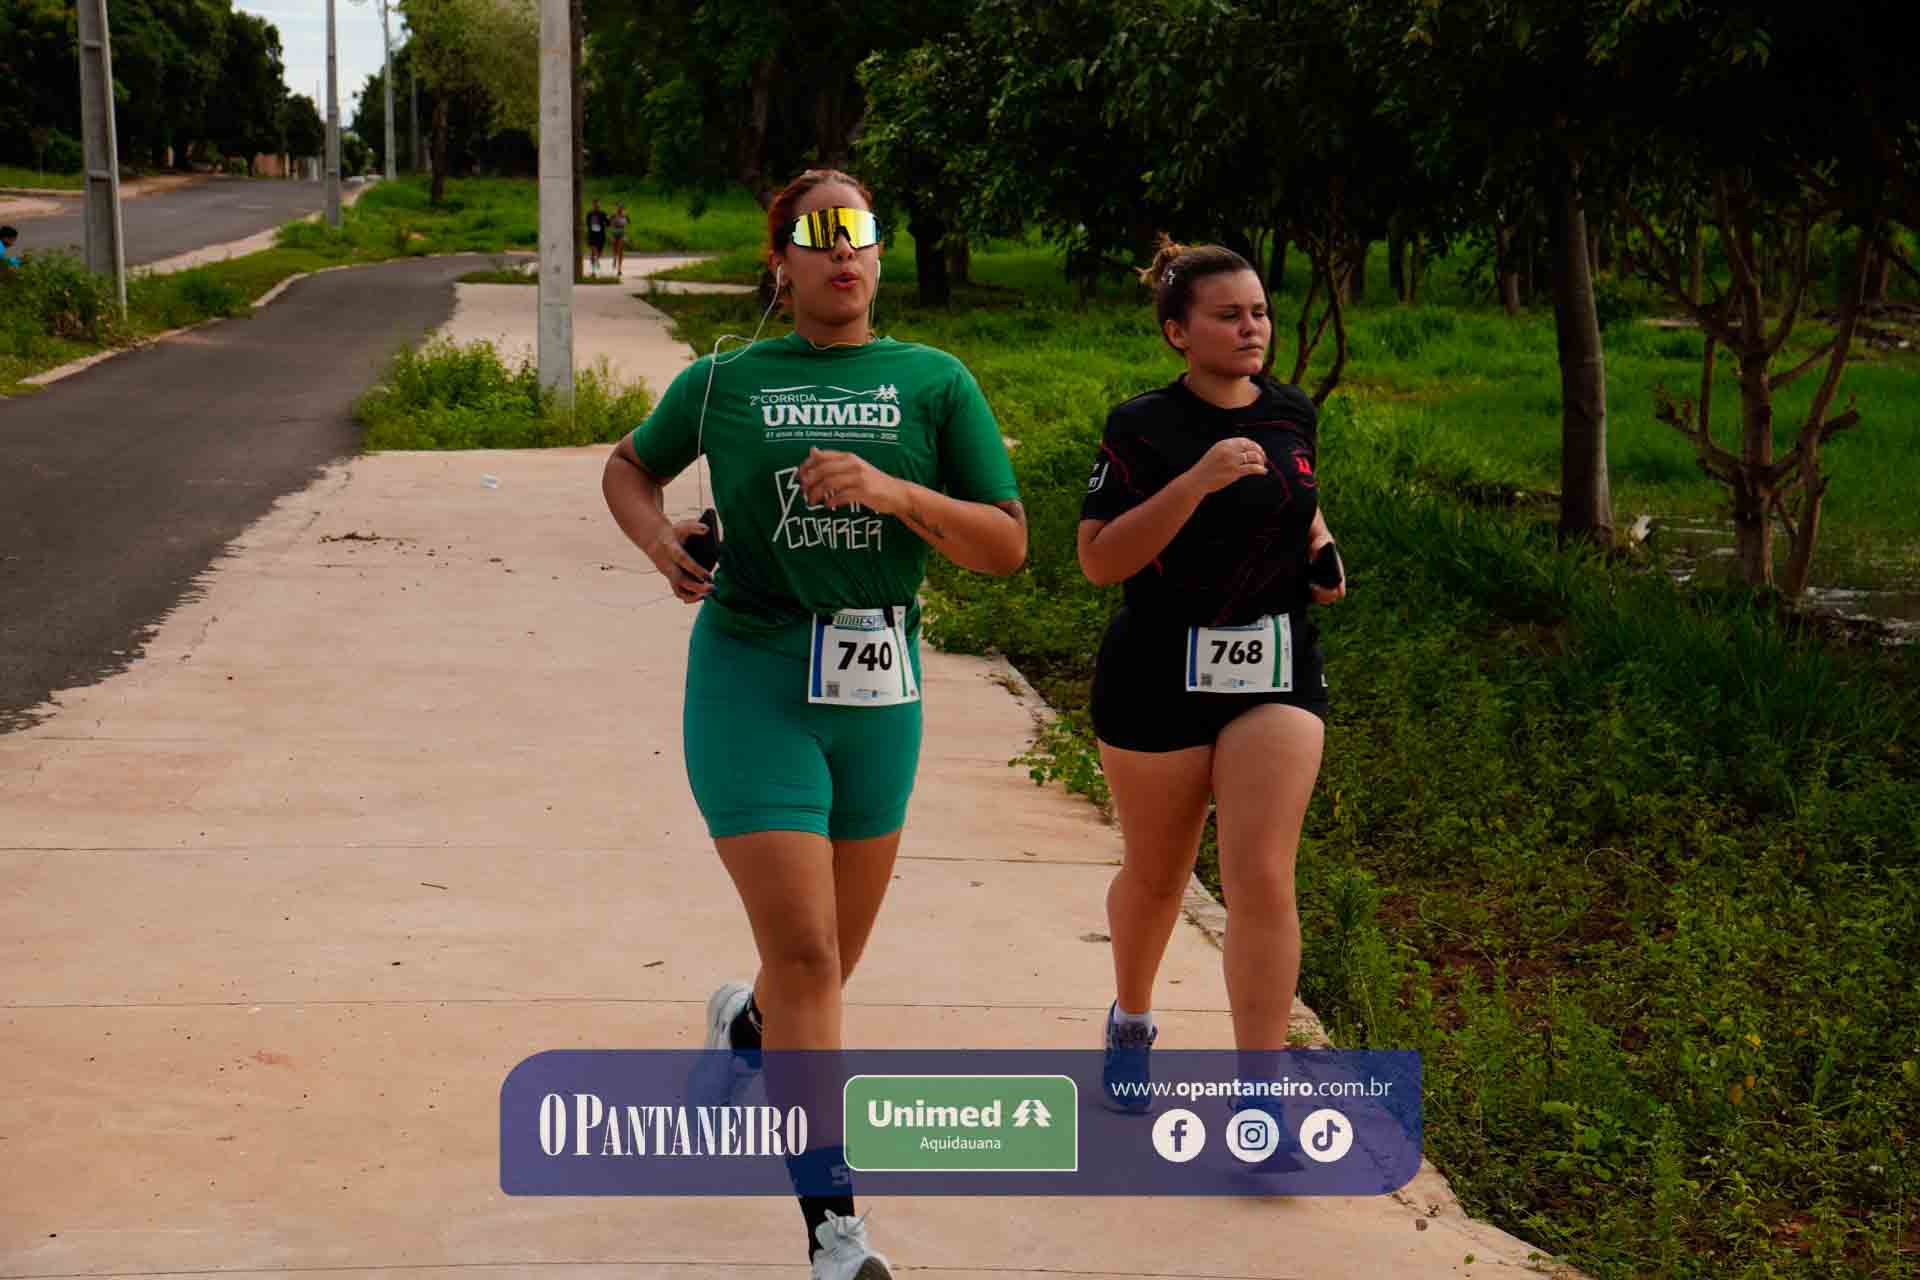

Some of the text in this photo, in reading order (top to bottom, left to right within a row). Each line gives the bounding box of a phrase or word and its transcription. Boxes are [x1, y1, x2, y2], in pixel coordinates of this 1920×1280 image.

[760, 393, 817, 404] CORRIDA
[762, 403, 901, 427] UNIMED
[785, 516, 882, 551] CORRER
[838, 641, 892, 671] 740
[1211, 640, 1262, 664] 768
